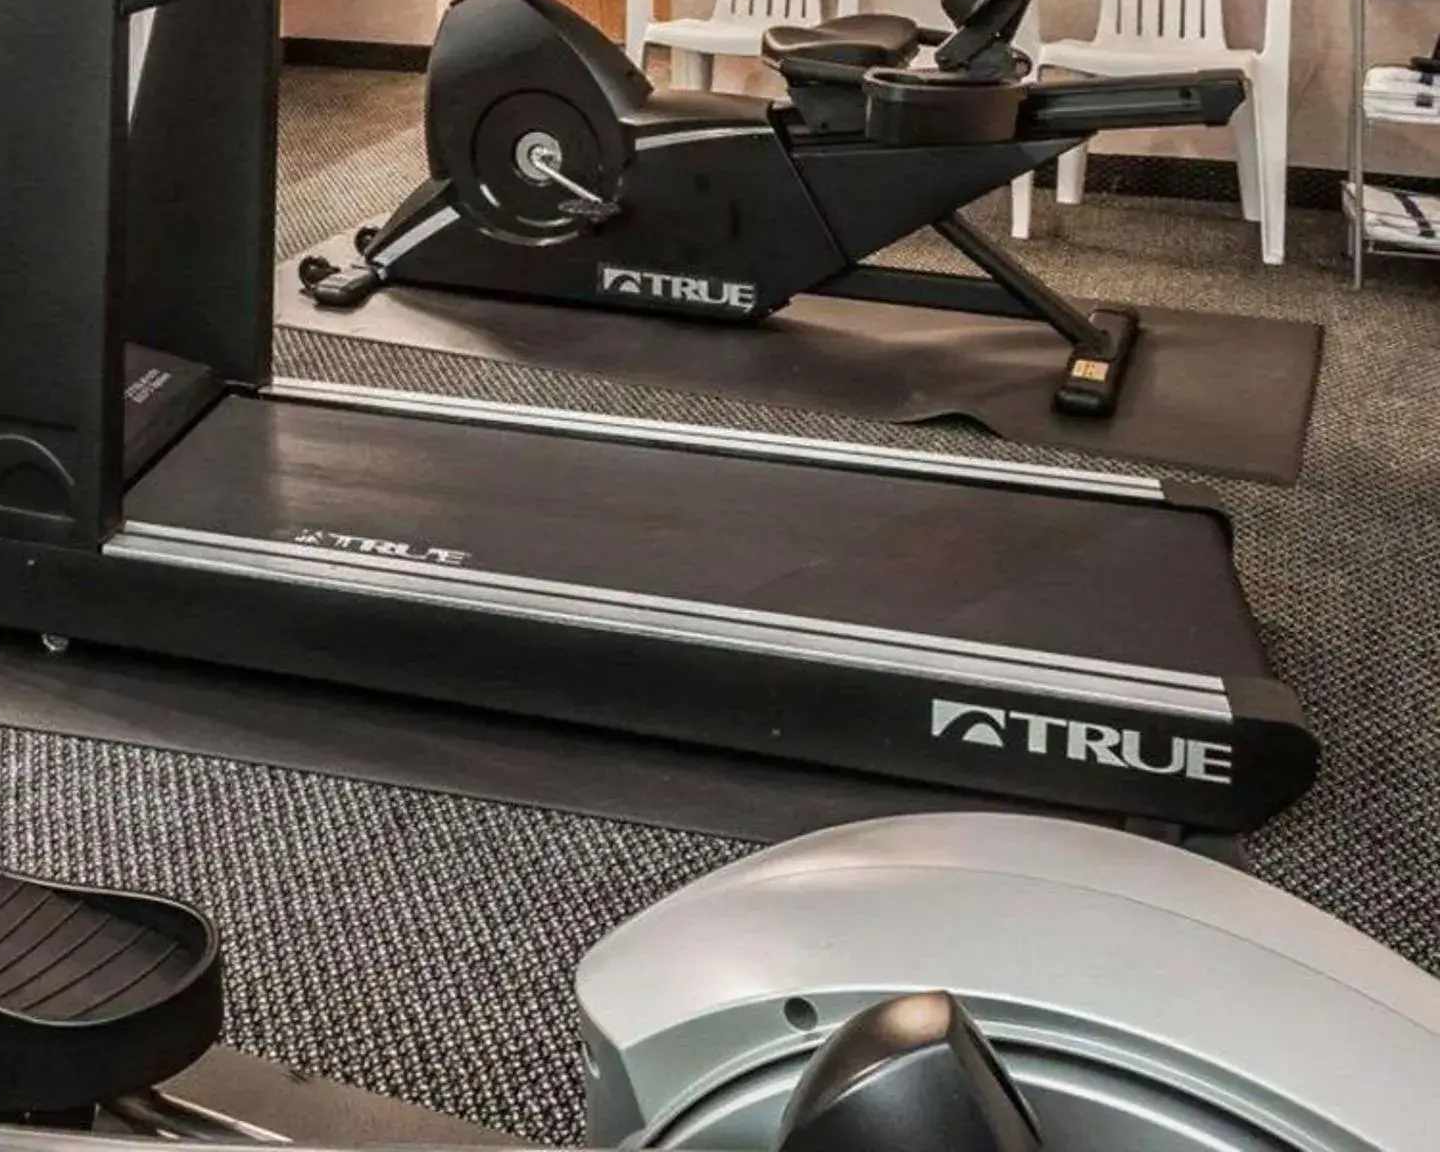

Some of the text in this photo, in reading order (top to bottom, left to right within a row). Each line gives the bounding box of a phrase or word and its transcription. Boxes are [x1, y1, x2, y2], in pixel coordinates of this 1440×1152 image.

[643, 271, 756, 310] TRUE
[327, 532, 472, 565] TRUE
[1009, 710, 1232, 784] TRUE
